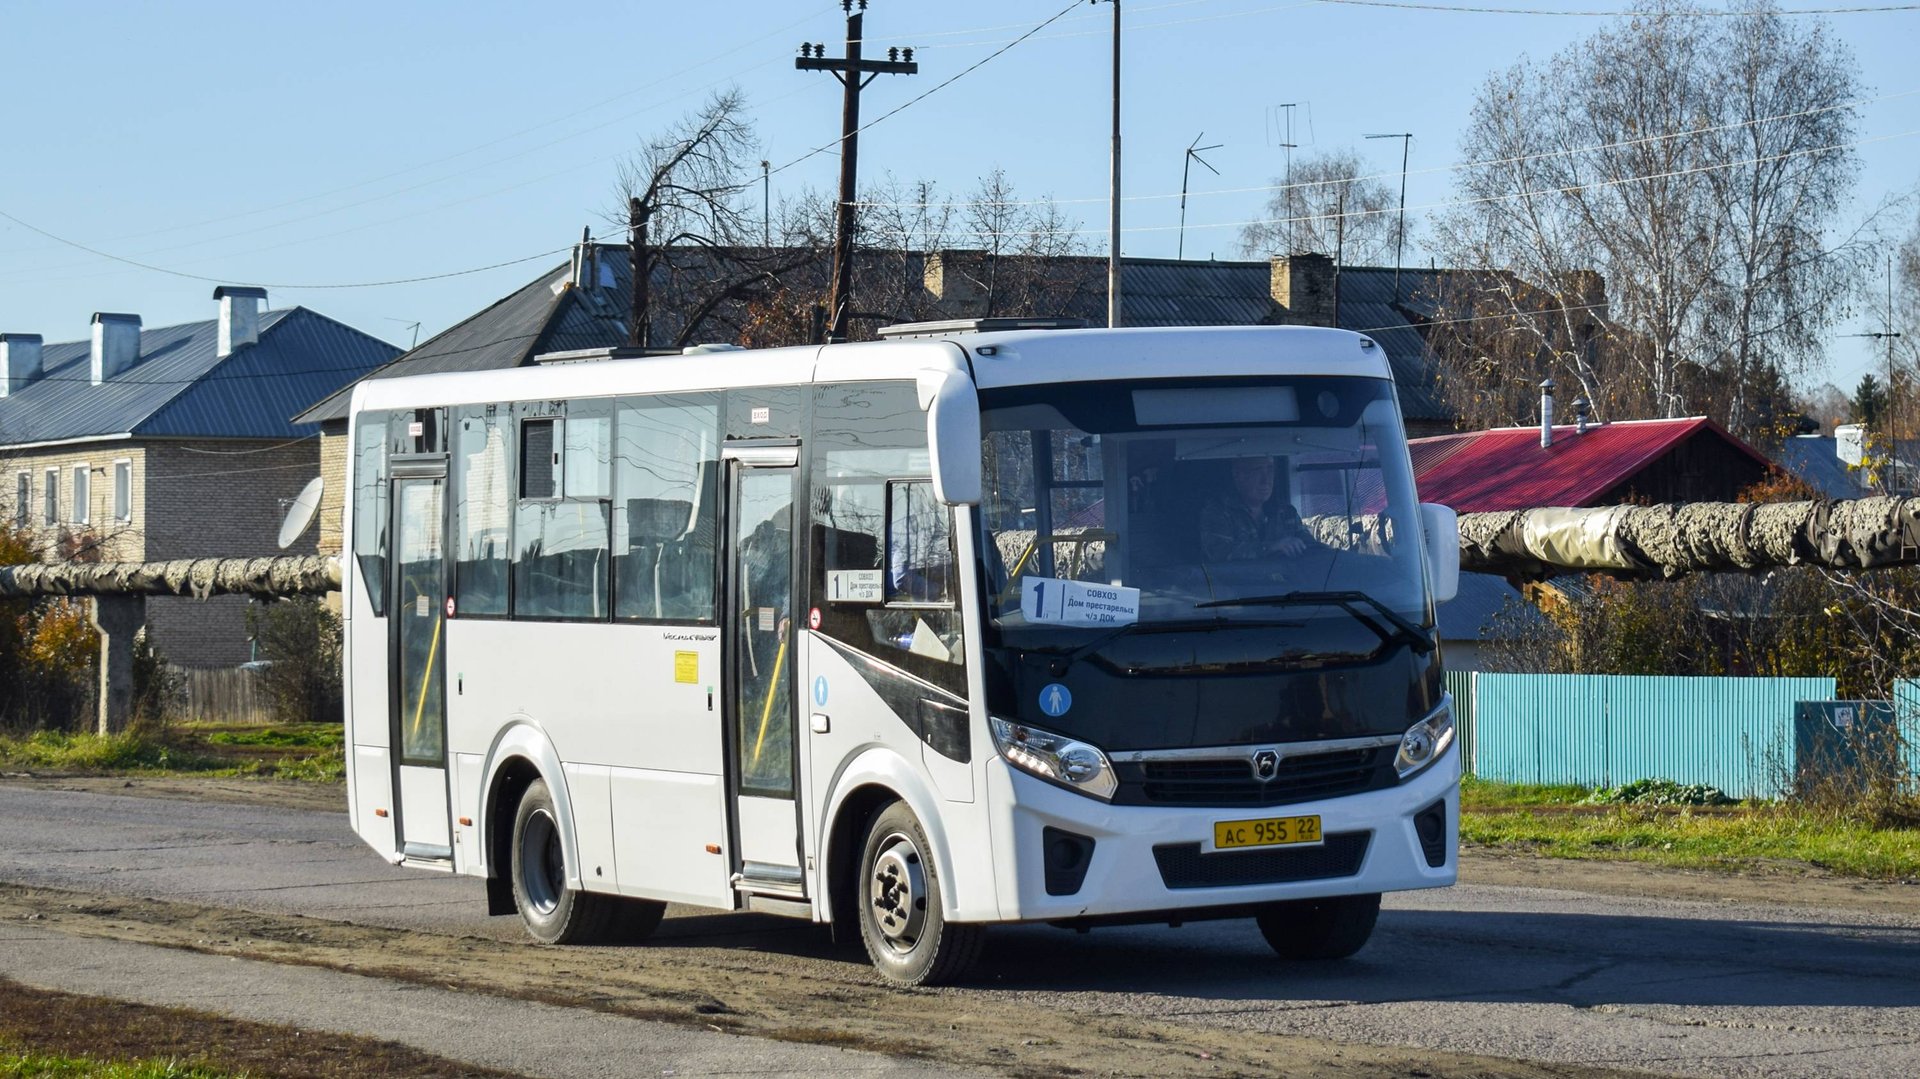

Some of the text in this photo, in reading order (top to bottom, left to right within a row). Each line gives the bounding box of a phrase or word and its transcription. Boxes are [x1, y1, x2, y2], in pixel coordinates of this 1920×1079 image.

[834, 574, 839, 599] 1
[1087, 589, 1117, 600] СОВХОЗ
[1033, 582, 1045, 618] 1
[1067, 598, 1134, 614] Дом престарелых
[1085, 612, 1115, 623] ч/з ДОК
[1254, 822, 1288, 842] 955
[1297, 818, 1315, 834] 22
[1225, 829, 1246, 844] АС
